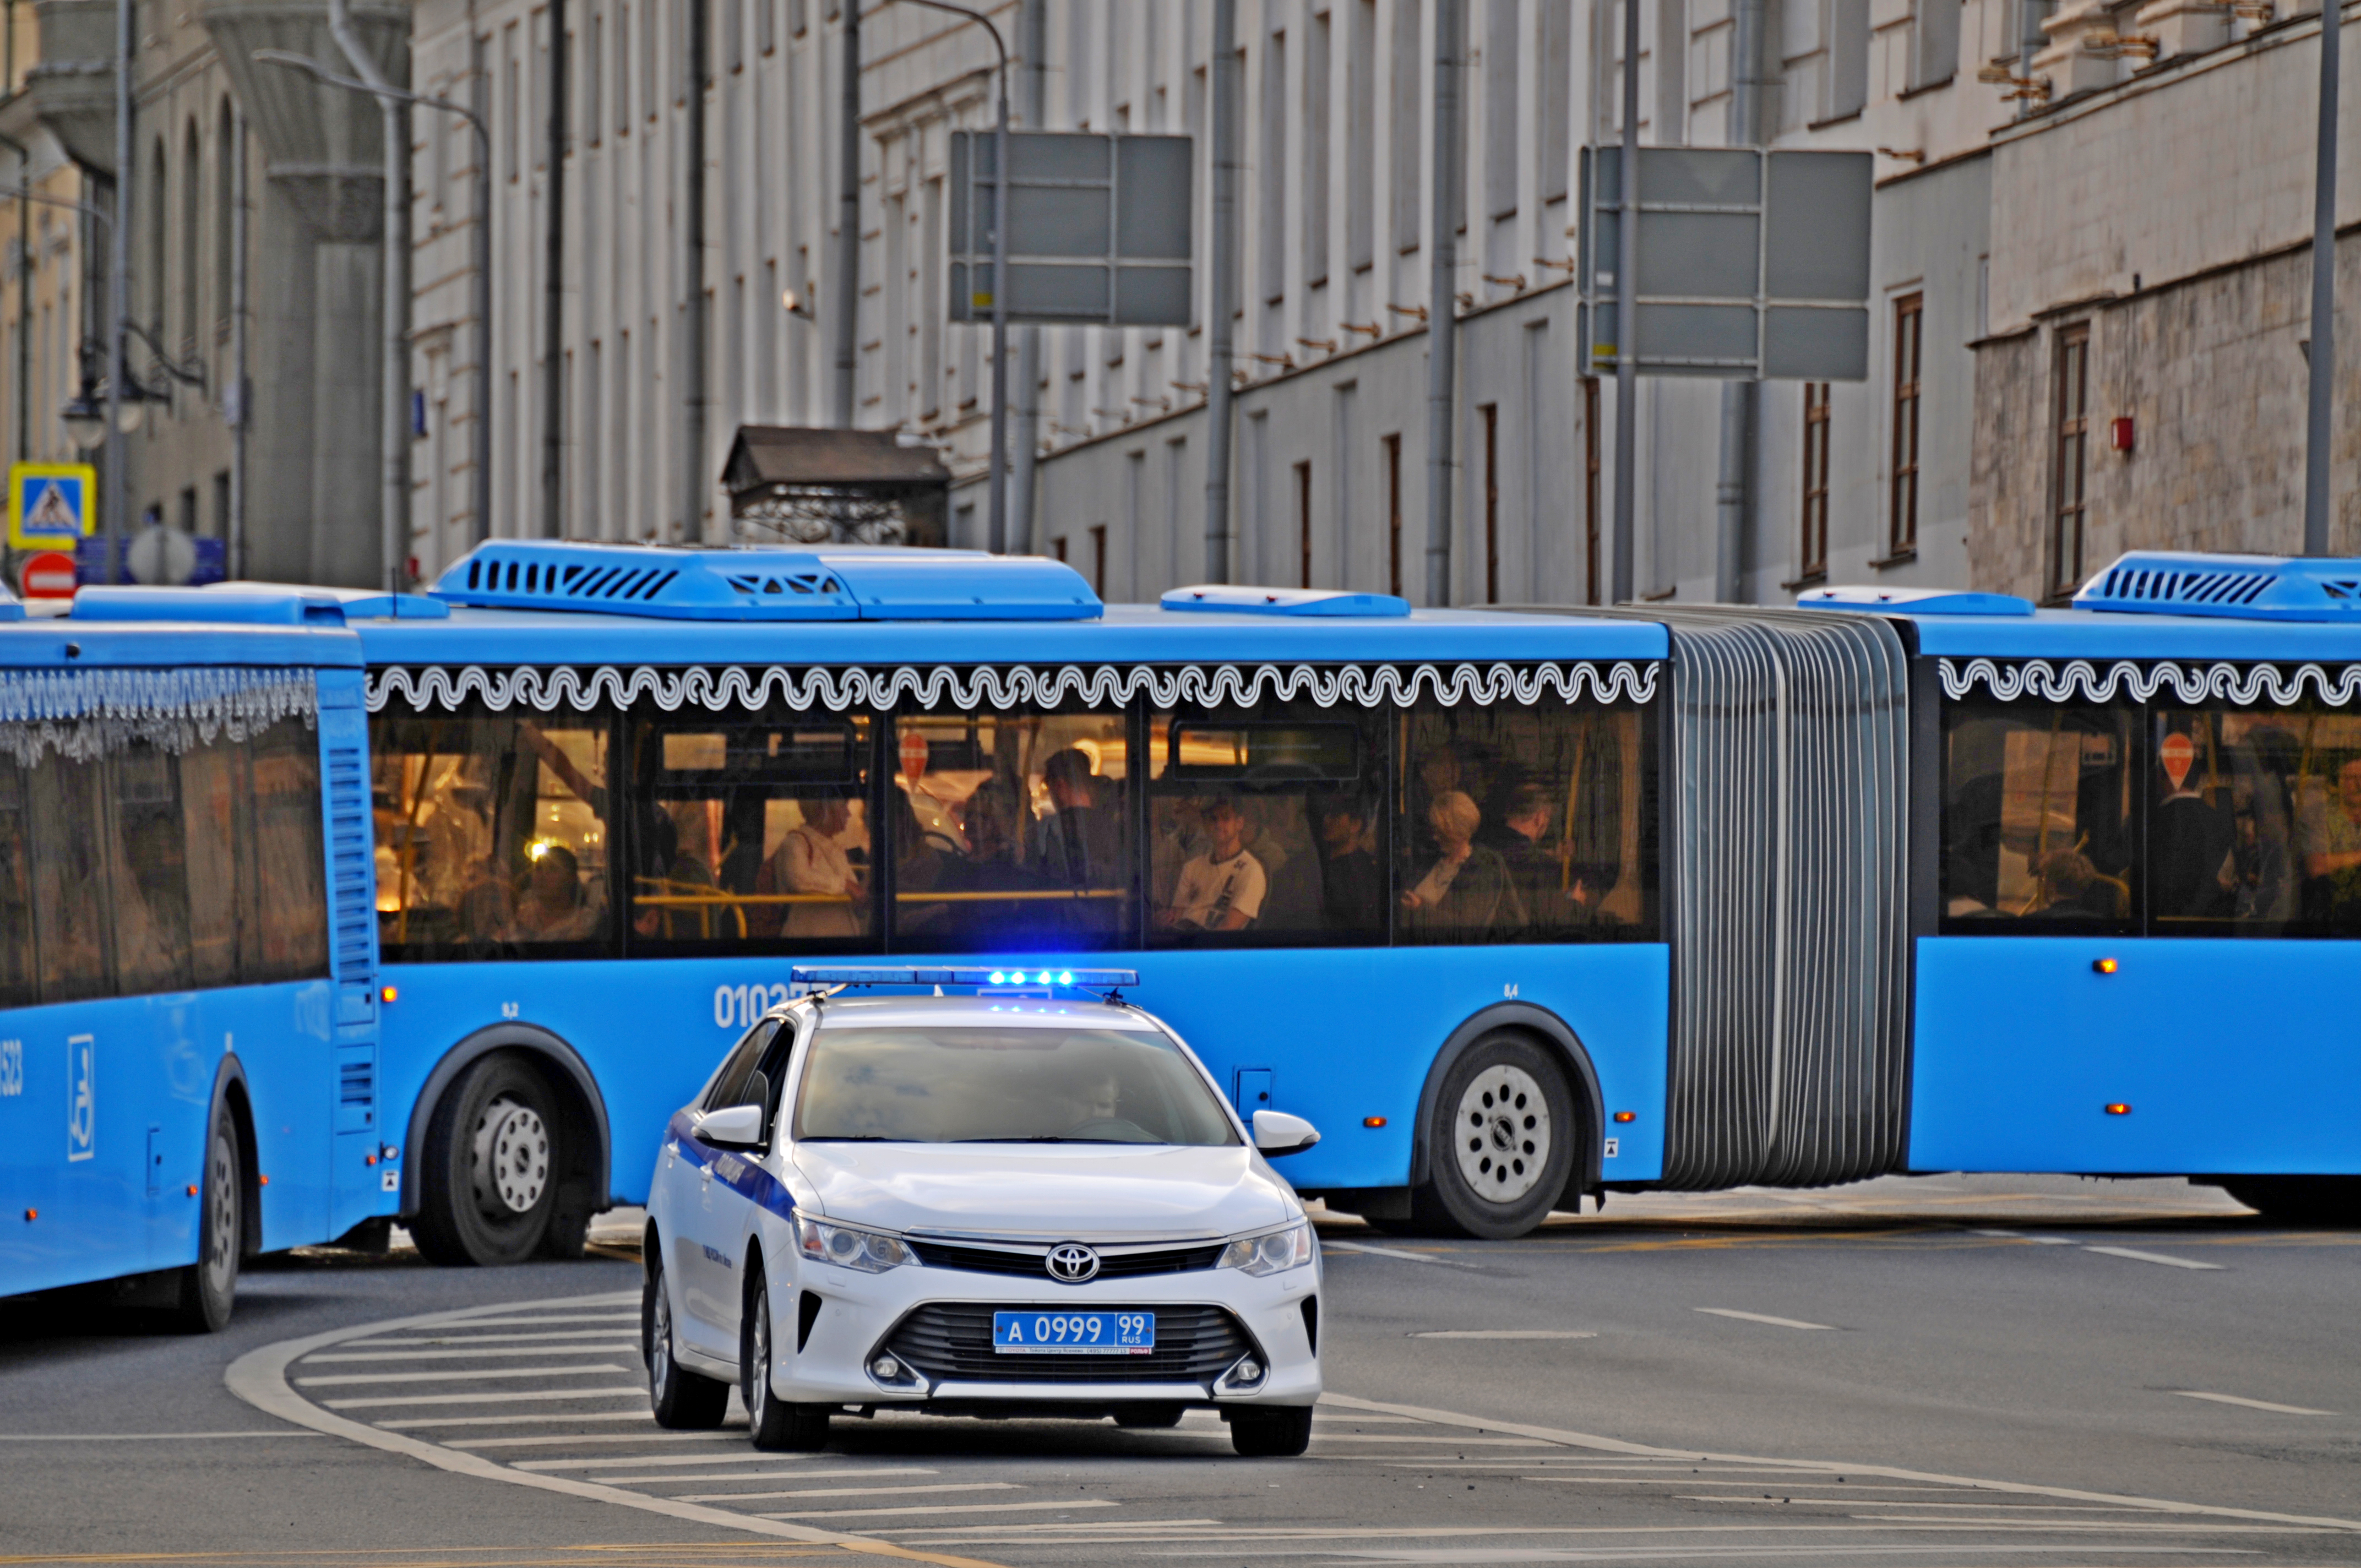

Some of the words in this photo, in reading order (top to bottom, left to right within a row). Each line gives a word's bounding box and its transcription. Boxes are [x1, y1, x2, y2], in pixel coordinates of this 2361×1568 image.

[714, 983, 831, 1028] 010
[0, 1039, 22, 1096] 523
[1035, 1316, 1102, 1342] 0999
[1119, 1315, 1145, 1336] 99
